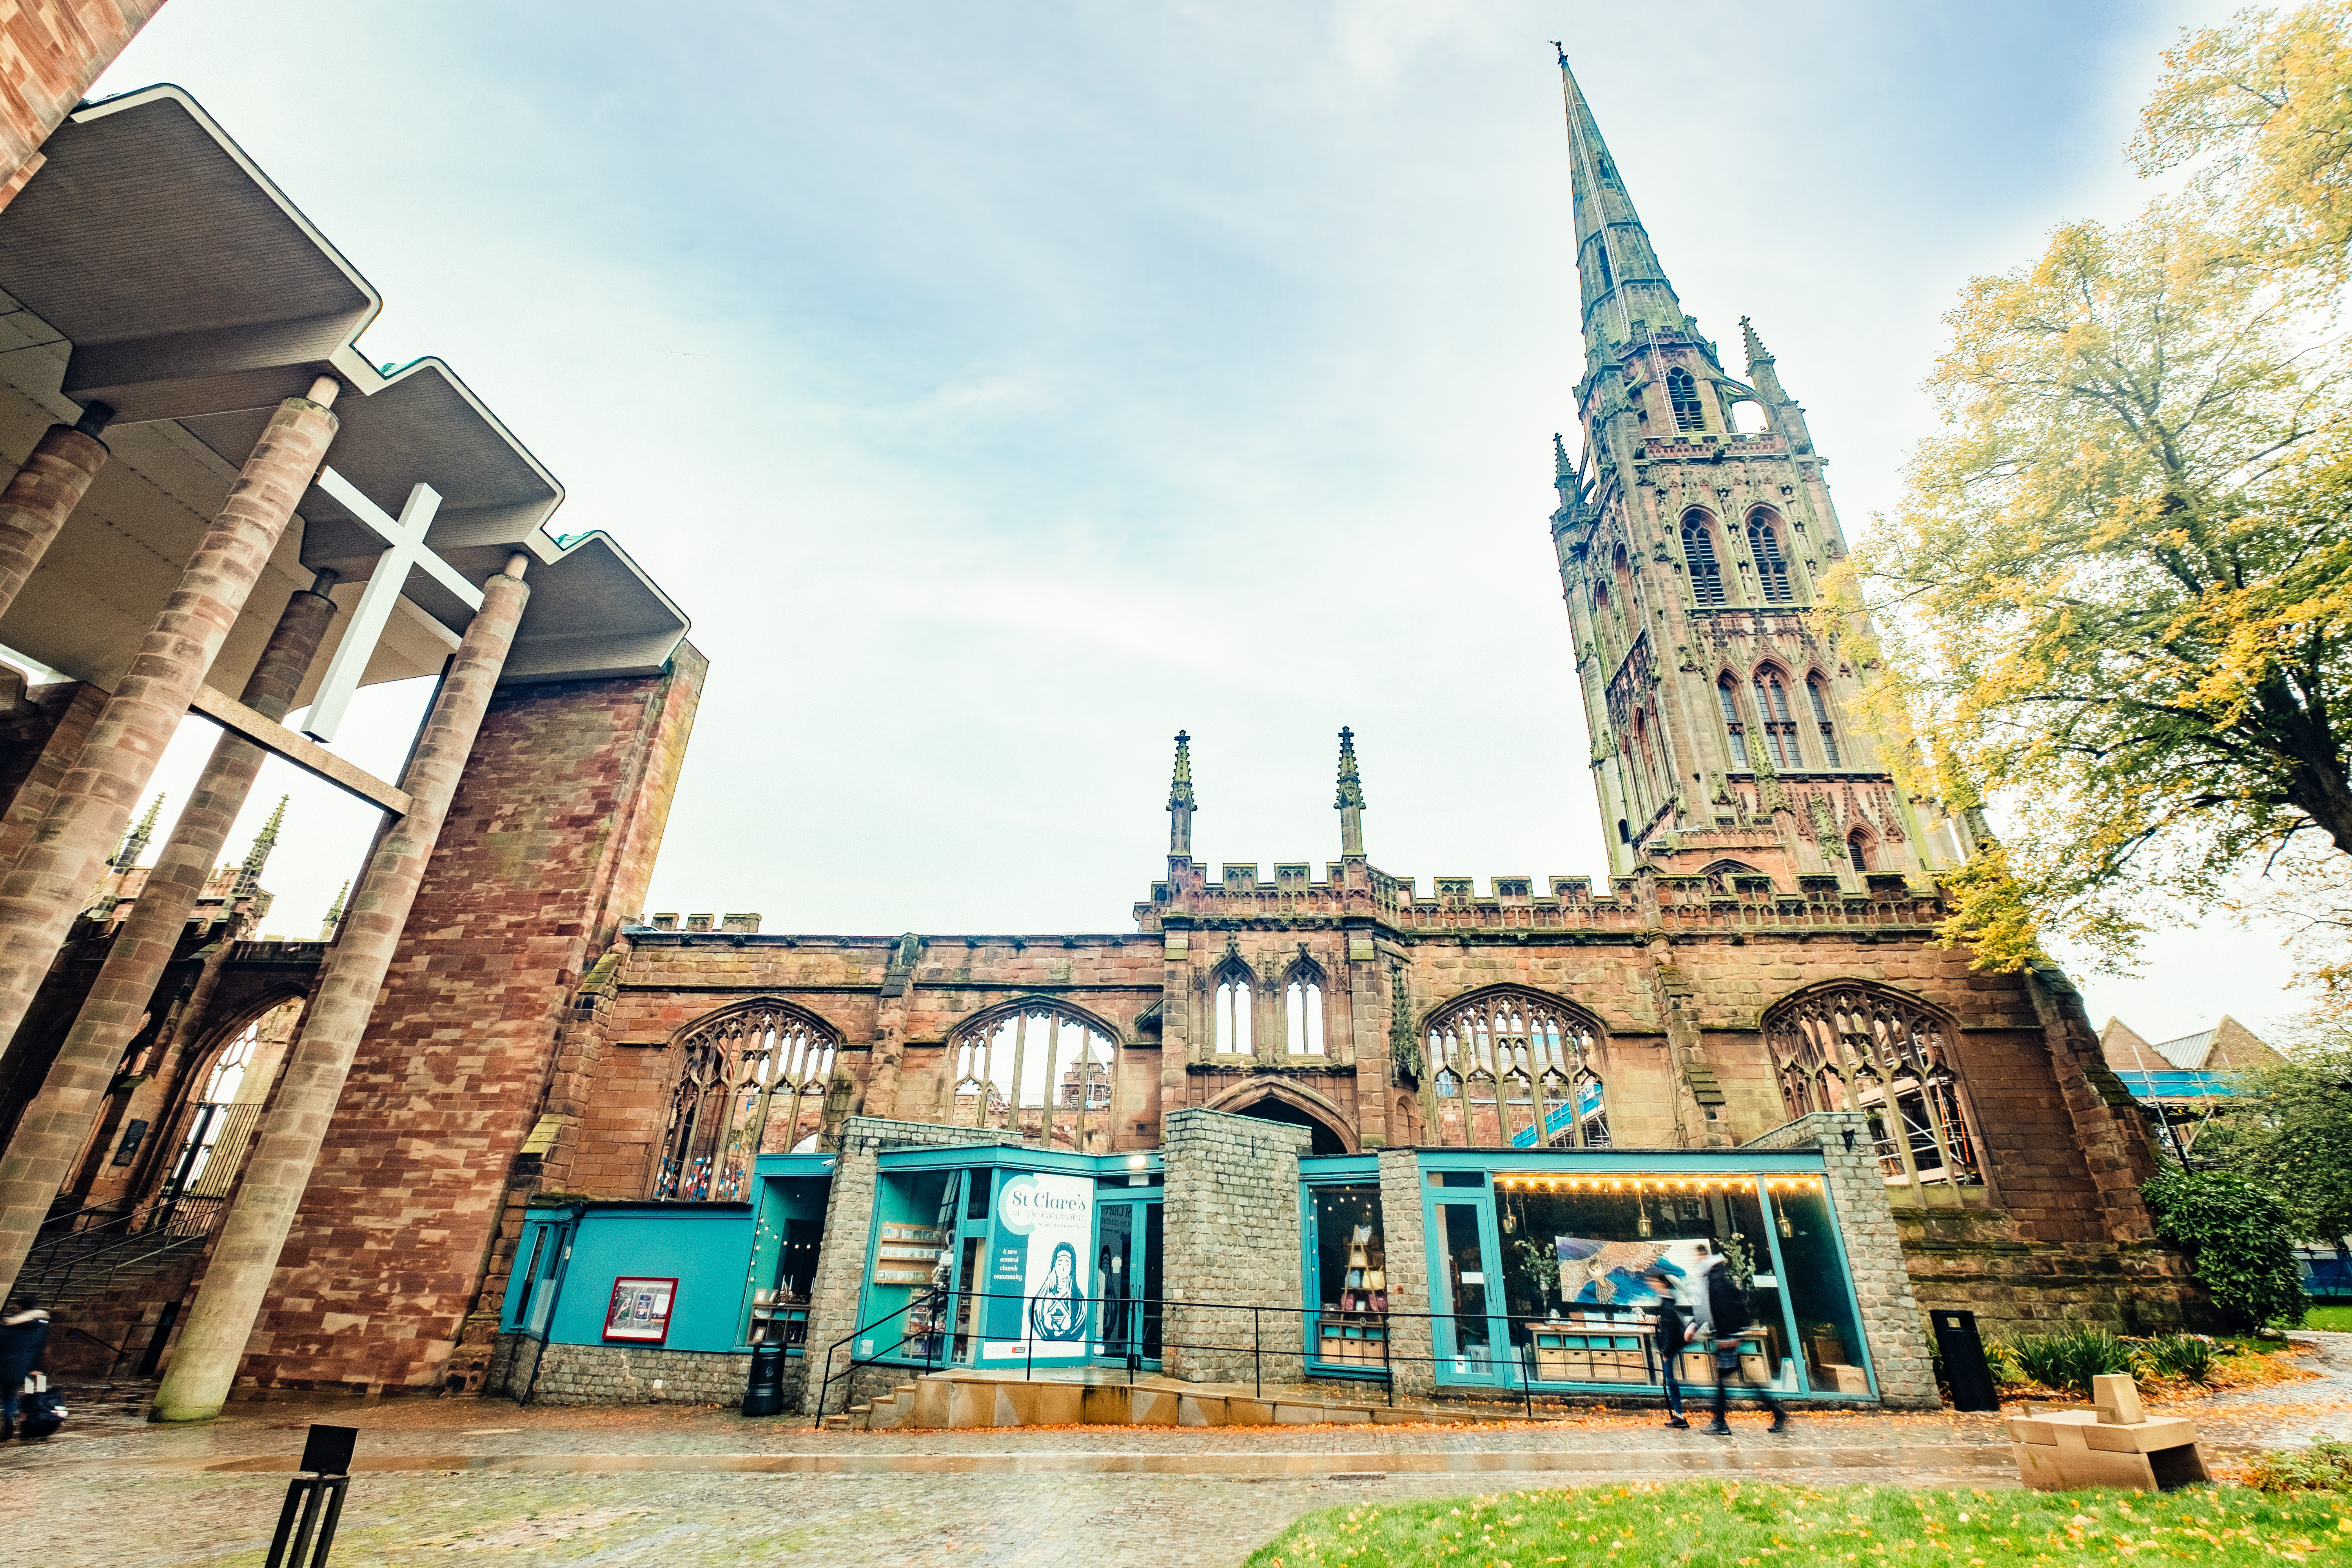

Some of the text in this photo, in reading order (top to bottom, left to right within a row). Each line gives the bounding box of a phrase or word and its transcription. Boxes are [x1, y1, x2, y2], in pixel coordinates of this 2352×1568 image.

[1013, 1191, 1085, 1211] St Clare's
[993, 1273, 1022, 1281] community
